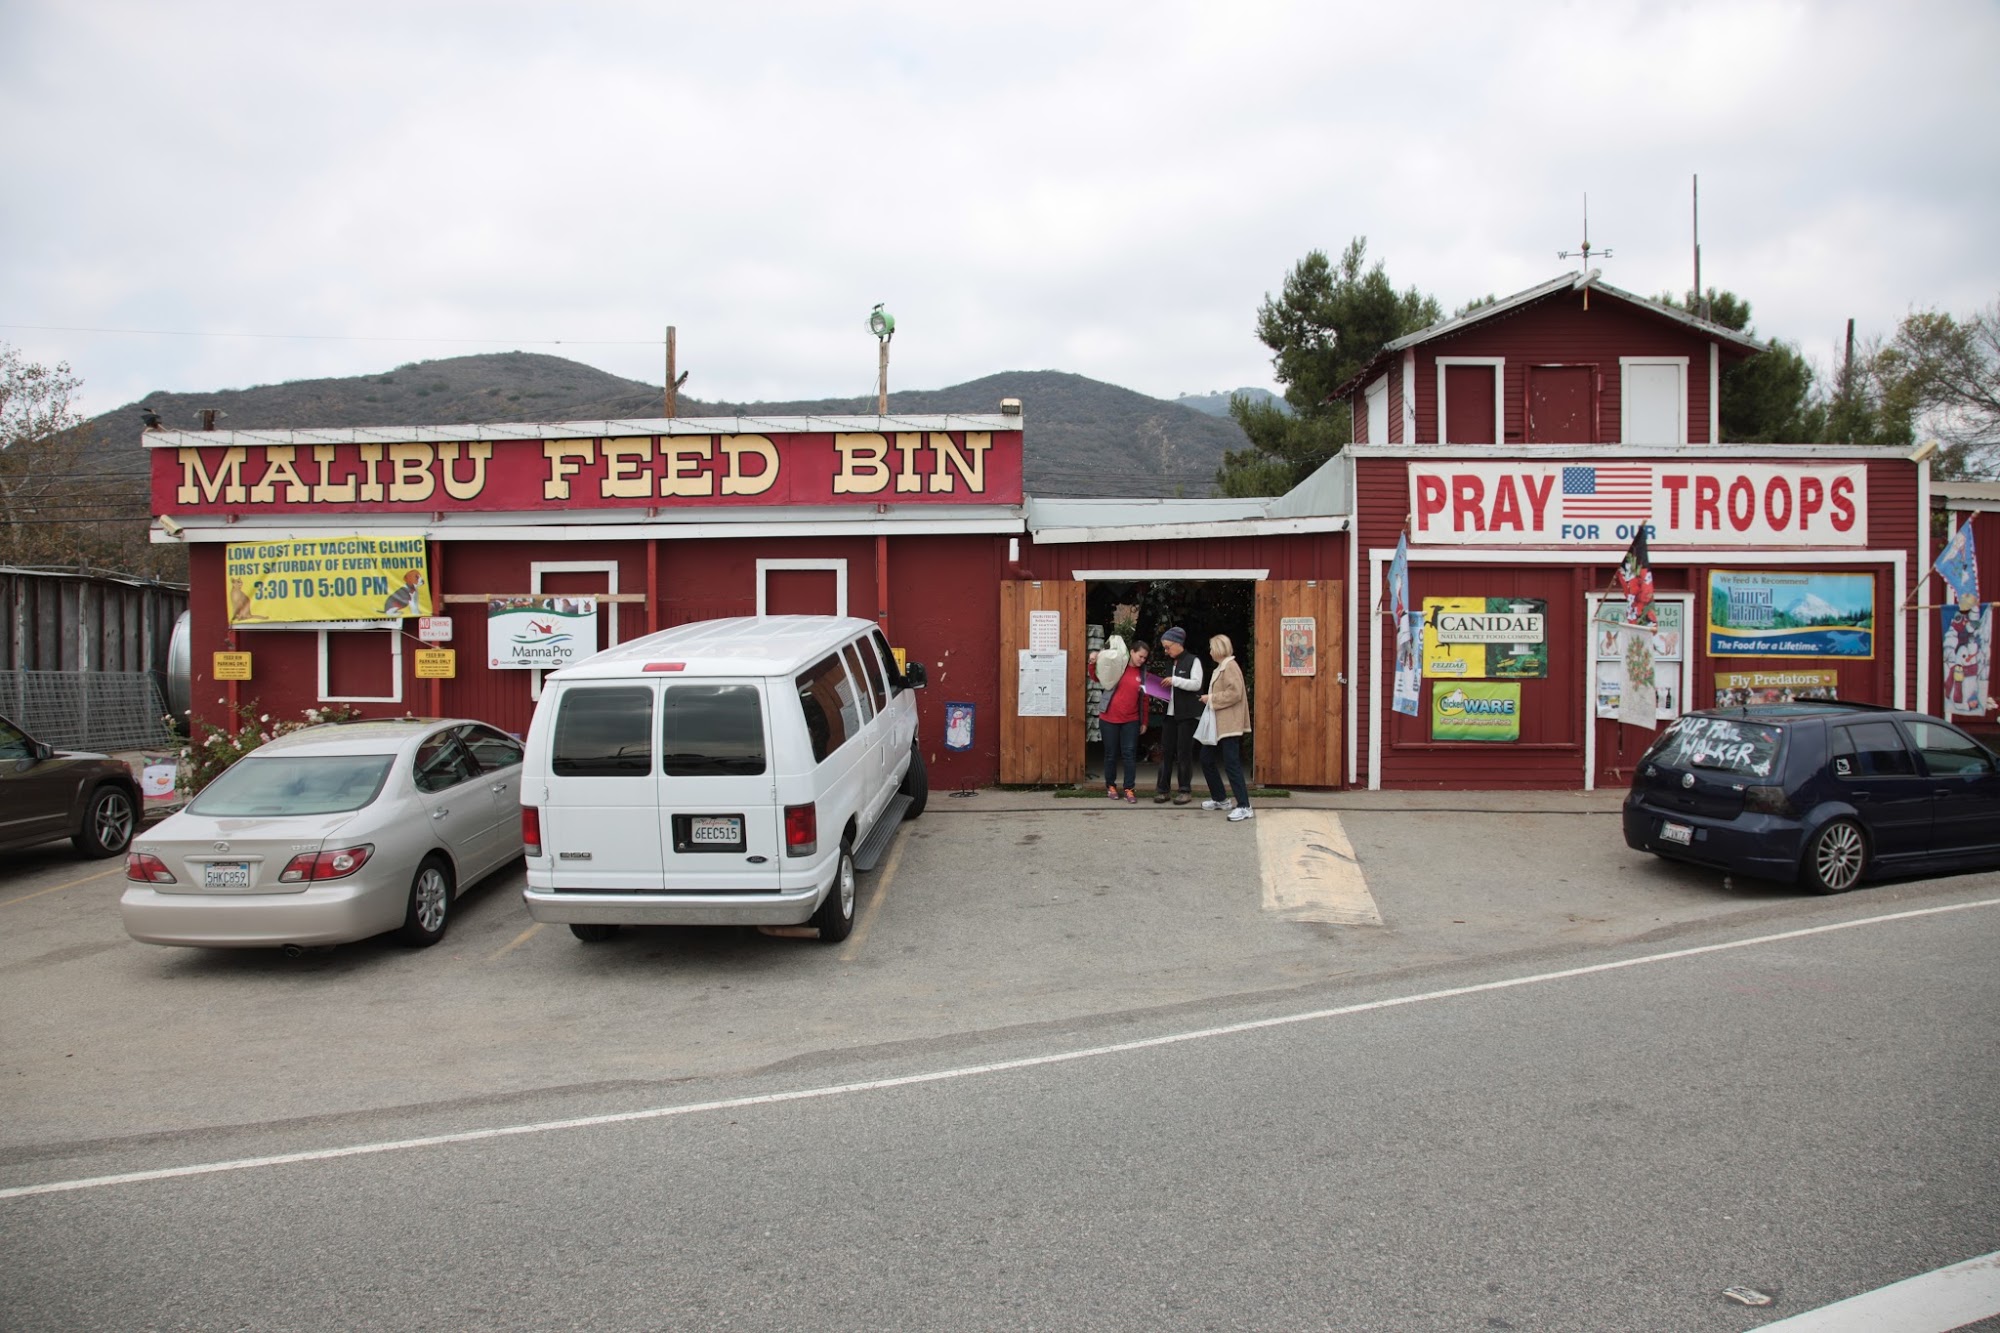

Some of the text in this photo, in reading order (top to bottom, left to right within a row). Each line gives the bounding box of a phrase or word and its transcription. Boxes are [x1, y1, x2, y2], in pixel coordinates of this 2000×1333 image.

[176, 431, 993, 506] MALIBU FEED BIN
[1417, 475, 1856, 532] PRAY TROOPS
[1562, 524, 1600, 540] FOR
[228, 539, 423, 561] LOW COST PET VACCINE CLINIC
[228, 556, 424, 576] FIRST SATURDAY OF EVERY MONTH
[254, 576, 388, 600] 3:30 TO 5:00 PM
[1664, 607, 1678, 617] Us
[420, 618, 430, 629] NO
[1440, 616, 1539, 632] CANIDAE
[512, 646, 572, 657] MannaPro
[1717, 640, 1732, 649] The
[1733, 641, 1756, 650] Food
[1757, 641, 1770, 650] for
[1779, 641, 1819, 651] Lifetime.
[1729, 675, 1751, 688] Fly
[1754, 674, 1819, 685] Predators
[1678, 737, 1755, 767] WALKER
[695, 827, 738, 840] 6EEC515
[207, 871, 246, 883] 5HKC859
